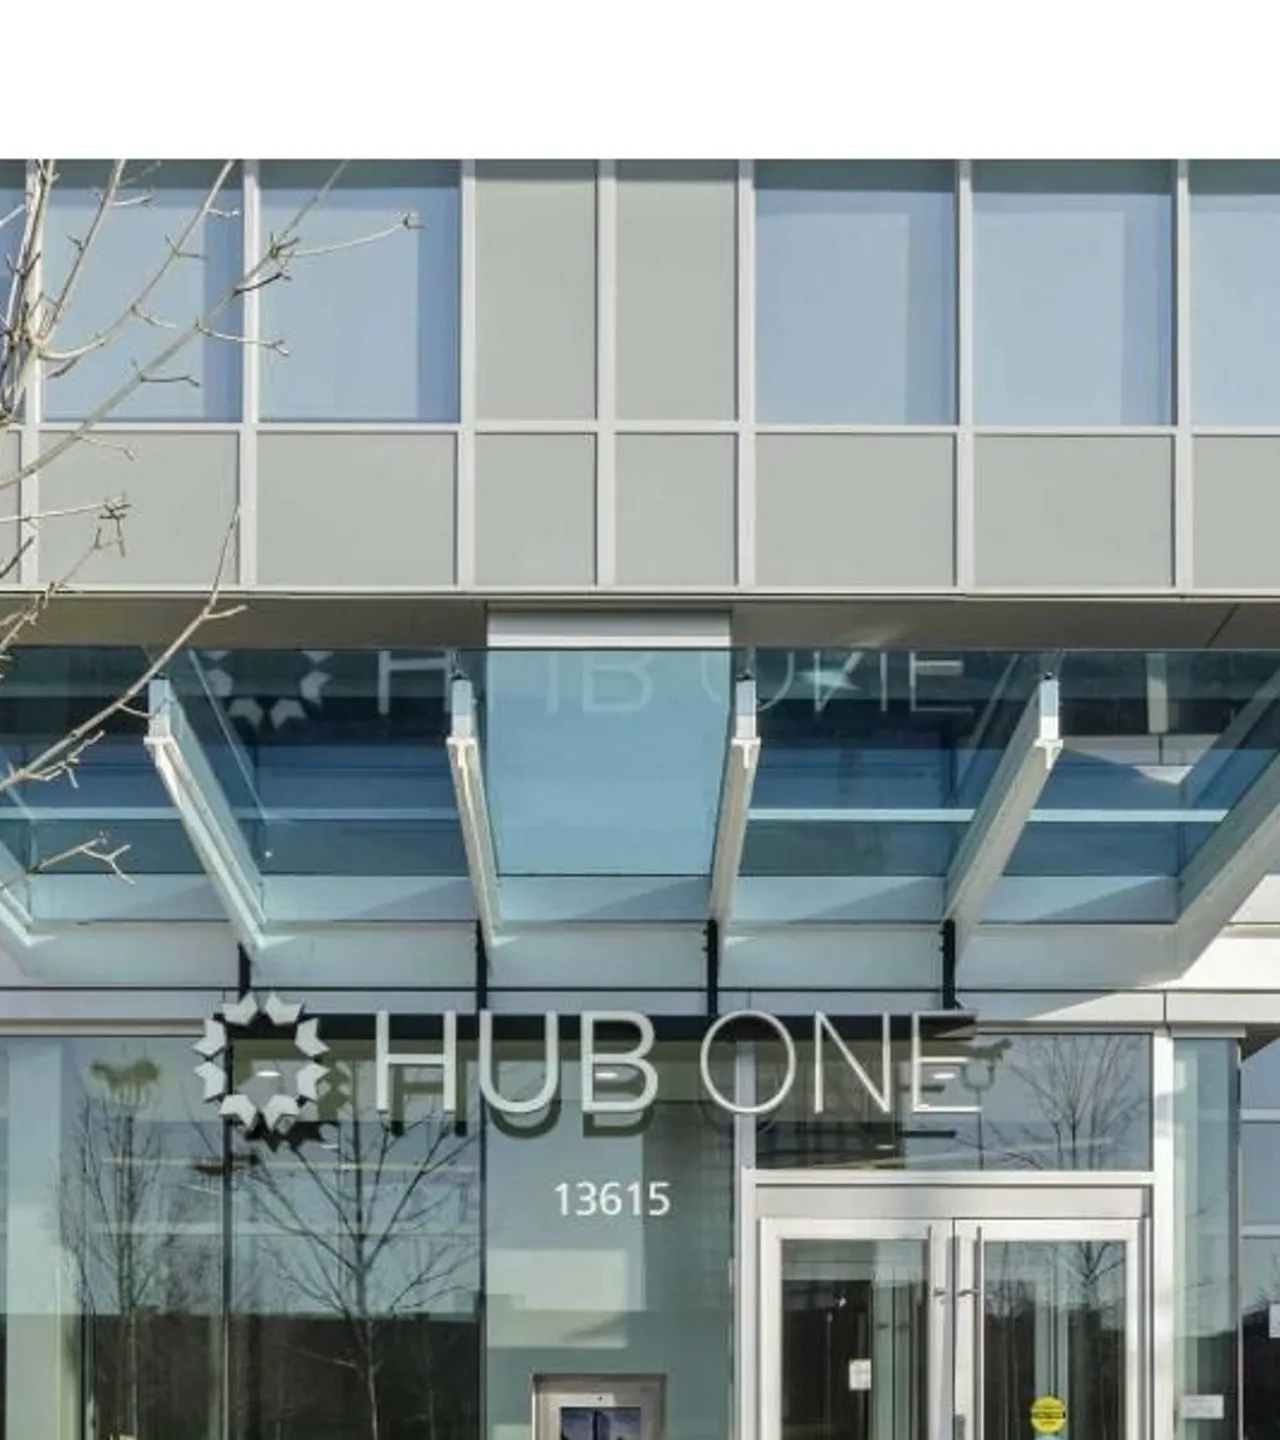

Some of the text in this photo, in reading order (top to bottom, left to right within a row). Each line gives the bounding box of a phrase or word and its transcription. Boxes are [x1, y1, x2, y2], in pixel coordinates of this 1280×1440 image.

[376, 1009, 982, 1114] HUB ONE
[553, 1181, 671, 1216] 13615
